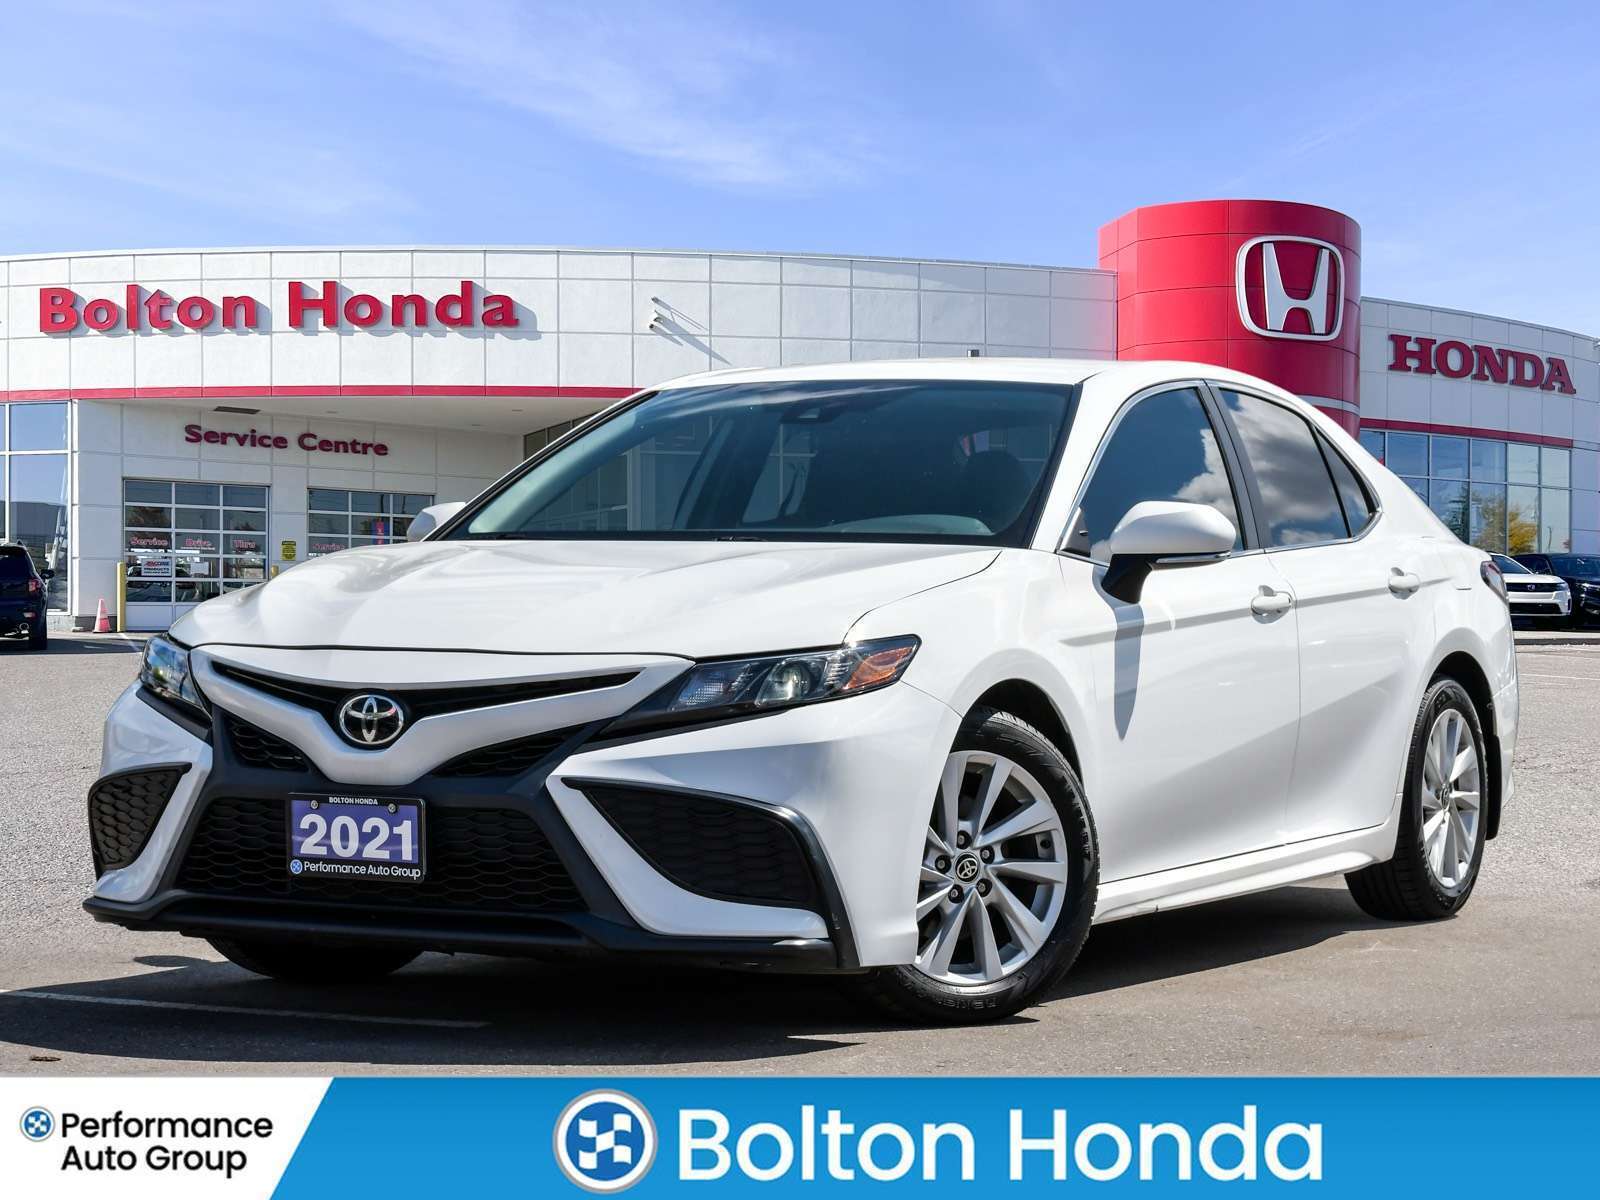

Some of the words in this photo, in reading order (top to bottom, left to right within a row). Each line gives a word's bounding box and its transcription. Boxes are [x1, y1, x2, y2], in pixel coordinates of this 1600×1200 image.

[40, 284, 257, 333] Bolton
[288, 280, 520, 329] Honda
[1388, 333, 1577, 395] HONDA
[184, 424, 288, 449] Service
[298, 432, 389, 456] Centre
[300, 813, 412, 861] 2021
[304, 861, 366, 874] Performance
[367, 864, 390, 876] Auto
[391, 866, 421, 880] Group
